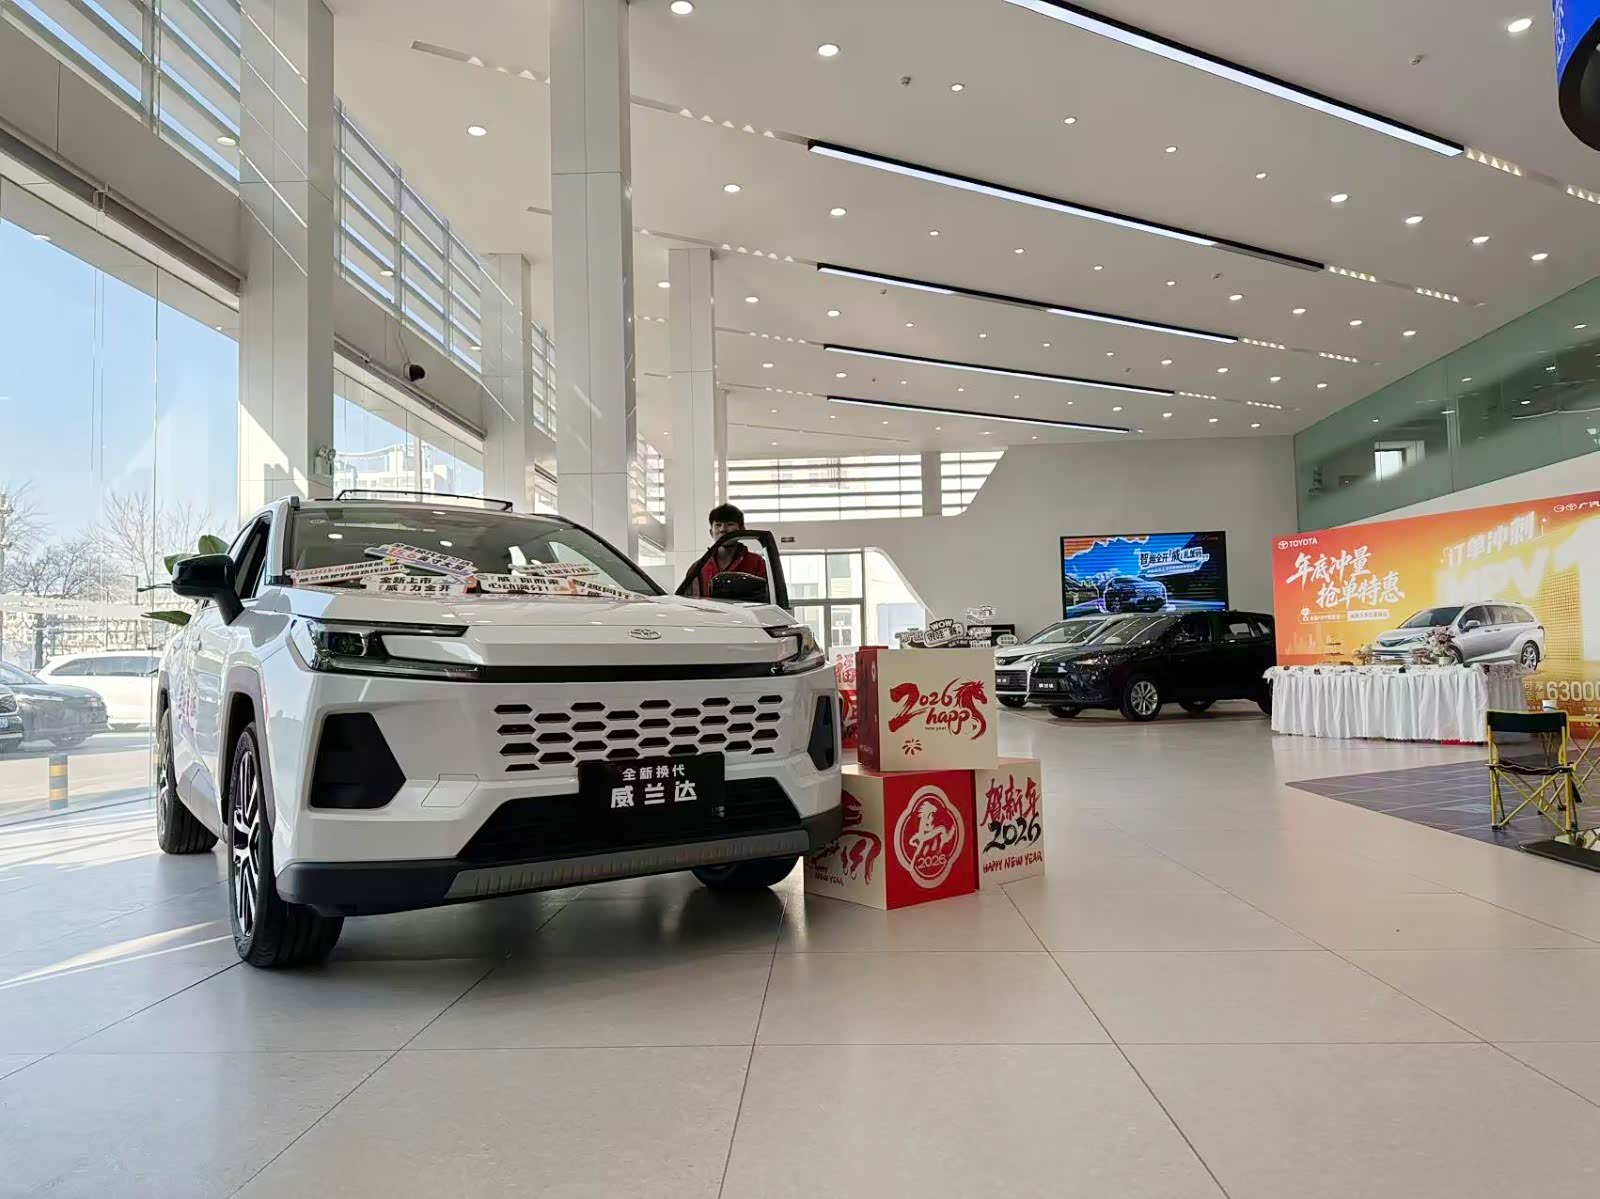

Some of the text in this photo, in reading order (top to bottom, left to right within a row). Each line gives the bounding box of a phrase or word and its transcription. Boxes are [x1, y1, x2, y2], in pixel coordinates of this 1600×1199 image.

[1289, 537, 1318, 548] TOYOTA
[1286, 545, 1372, 591] 年底冲量
[1316, 570, 1406, 609] 抢单特惠
[930, 618, 954, 631] WOW
[888, 677, 960, 733] 2026
[622, 763, 686, 782] 全新换代
[610, 780, 698, 809] 威兰达
[980, 774, 1038, 827] 贺新年
[983, 811, 1042, 854] 2026
[917, 854, 948, 869] 2026
[983, 851, 1043, 873] HAPPY NEW YEAR
